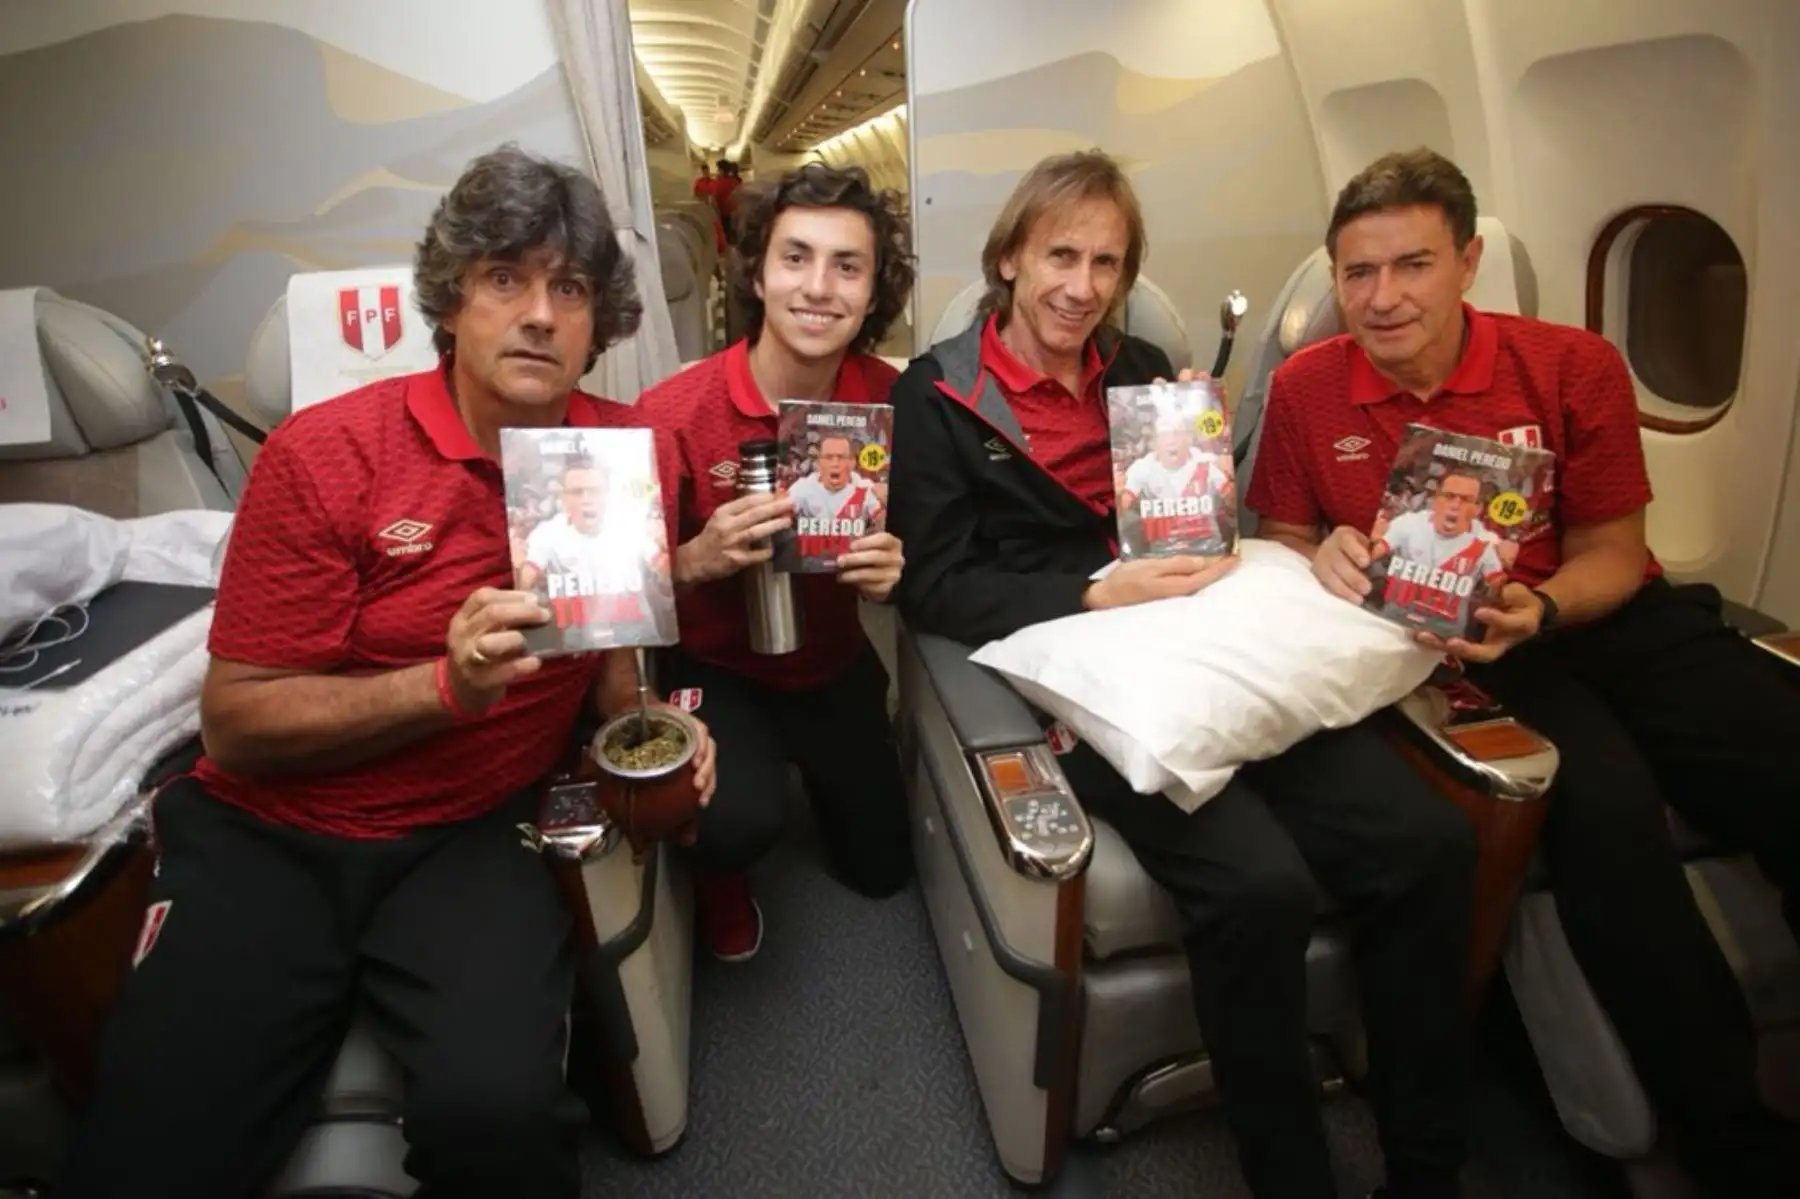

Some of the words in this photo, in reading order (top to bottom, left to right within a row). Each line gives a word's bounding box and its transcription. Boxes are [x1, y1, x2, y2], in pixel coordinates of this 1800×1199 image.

[1432, 443, 1469, 461] DANIEL
[1470, 449, 1512, 470] PEREDO
[1140, 495, 1212, 518] PEREDO
[797, 516, 864, 537] PEREDO
[1387, 556, 1473, 596] PEREDO
